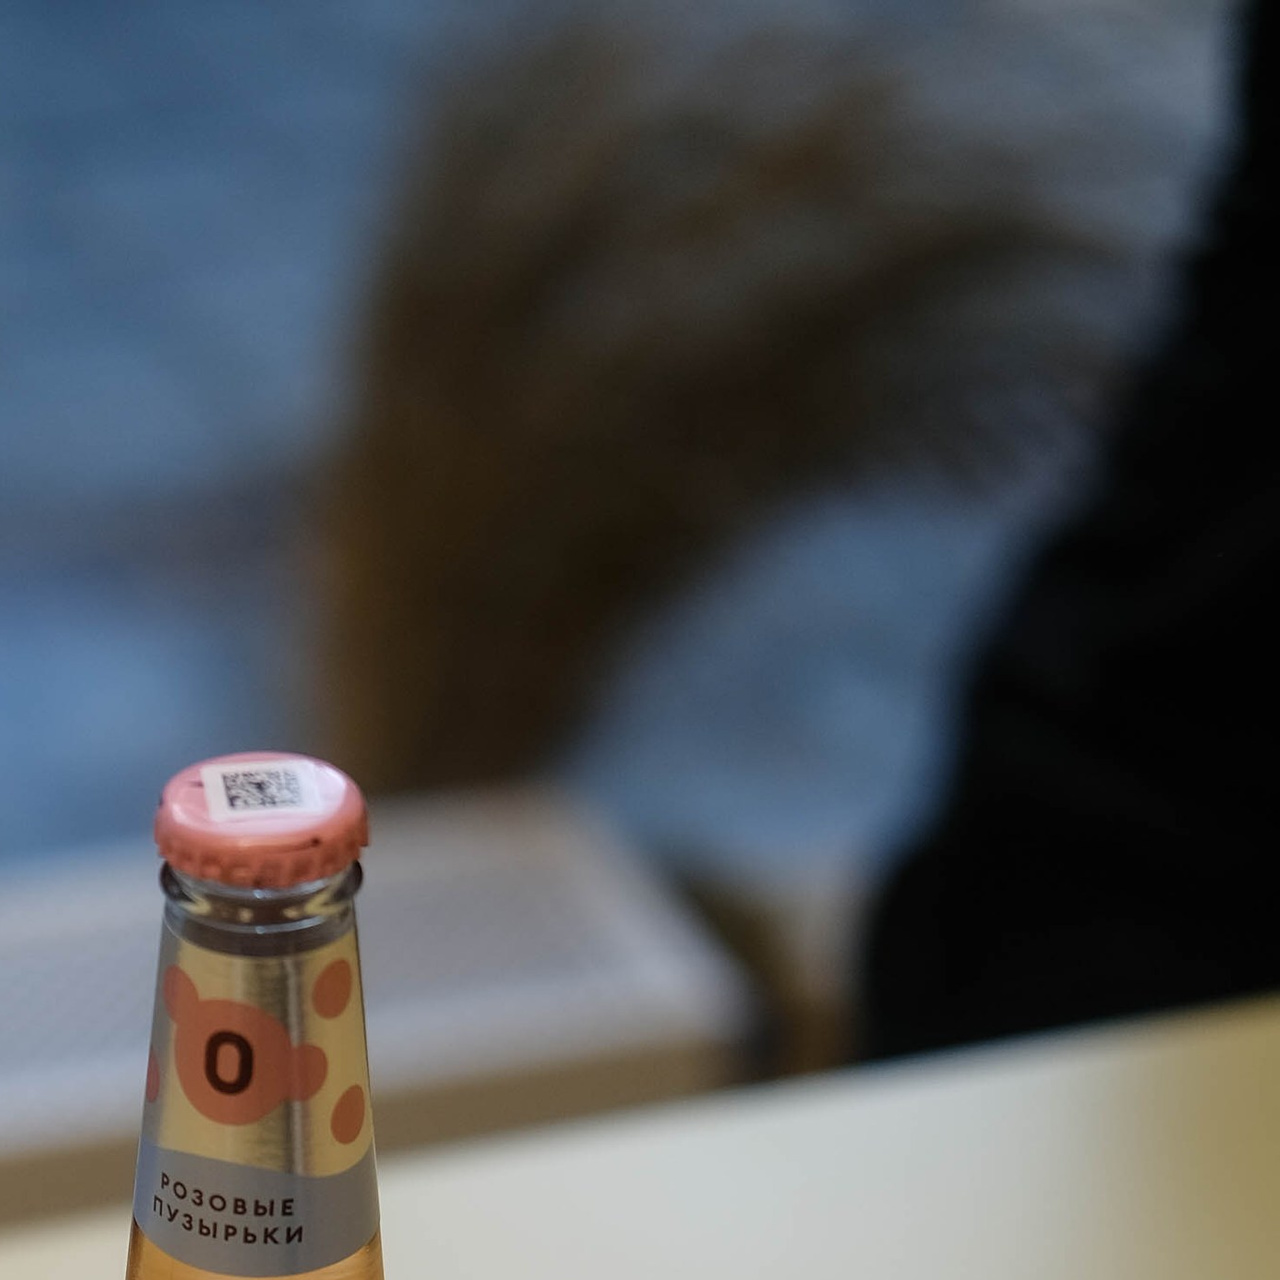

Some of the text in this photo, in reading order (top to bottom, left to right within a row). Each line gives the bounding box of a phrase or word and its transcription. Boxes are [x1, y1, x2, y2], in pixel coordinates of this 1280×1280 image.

[206, 1031, 254, 1095] 0
[160, 1171, 296, 1218] РОЗОВЫЕ
[151, 1195, 304, 1245] ПУЗЫРЬКИ
